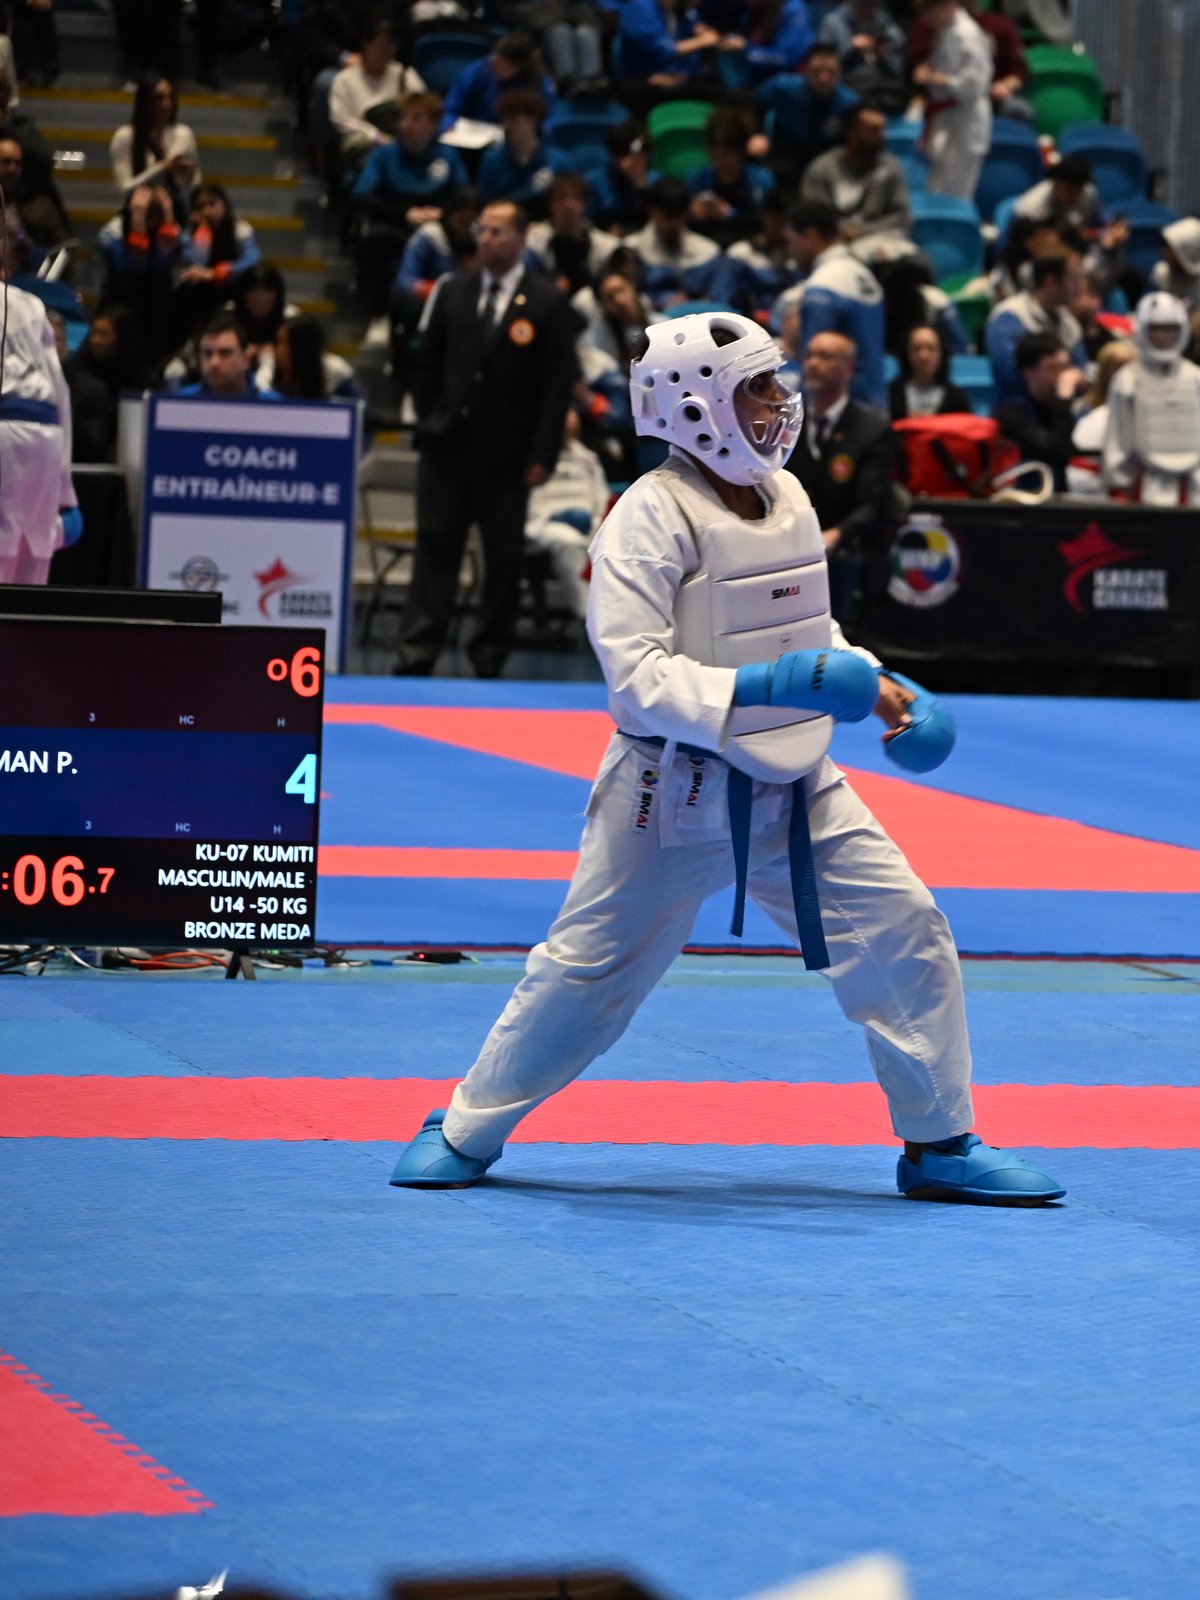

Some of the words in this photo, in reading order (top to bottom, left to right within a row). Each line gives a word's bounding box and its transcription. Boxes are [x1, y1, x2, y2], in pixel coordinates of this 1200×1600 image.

[204, 445, 297, 469] COACH
[771, 585, 801, 600] SMAI
[89, 713, 96, 722] 3
[179, 715, 194, 724] HC
[277, 718, 285, 727] H
[57, 751, 78, 775] P.
[285, 753, 317, 804] 4
[687, 772, 703, 806] SMAI
[636, 791, 653, 829] SMAI
[85, 820, 92, 830] 3
[175, 823, 191, 832] HC
[274, 825, 281, 834] H
[195, 844, 249, 861] KU-07
[158, 869, 306, 889] MASCULIN/MALE
[210, 896, 245, 913] U14
[249, 897, 279, 914] -50
[282, 897, 308, 915] KG
[185, 921, 257, 939] BRONZE
[260, 923, 311, 940] MEDA
